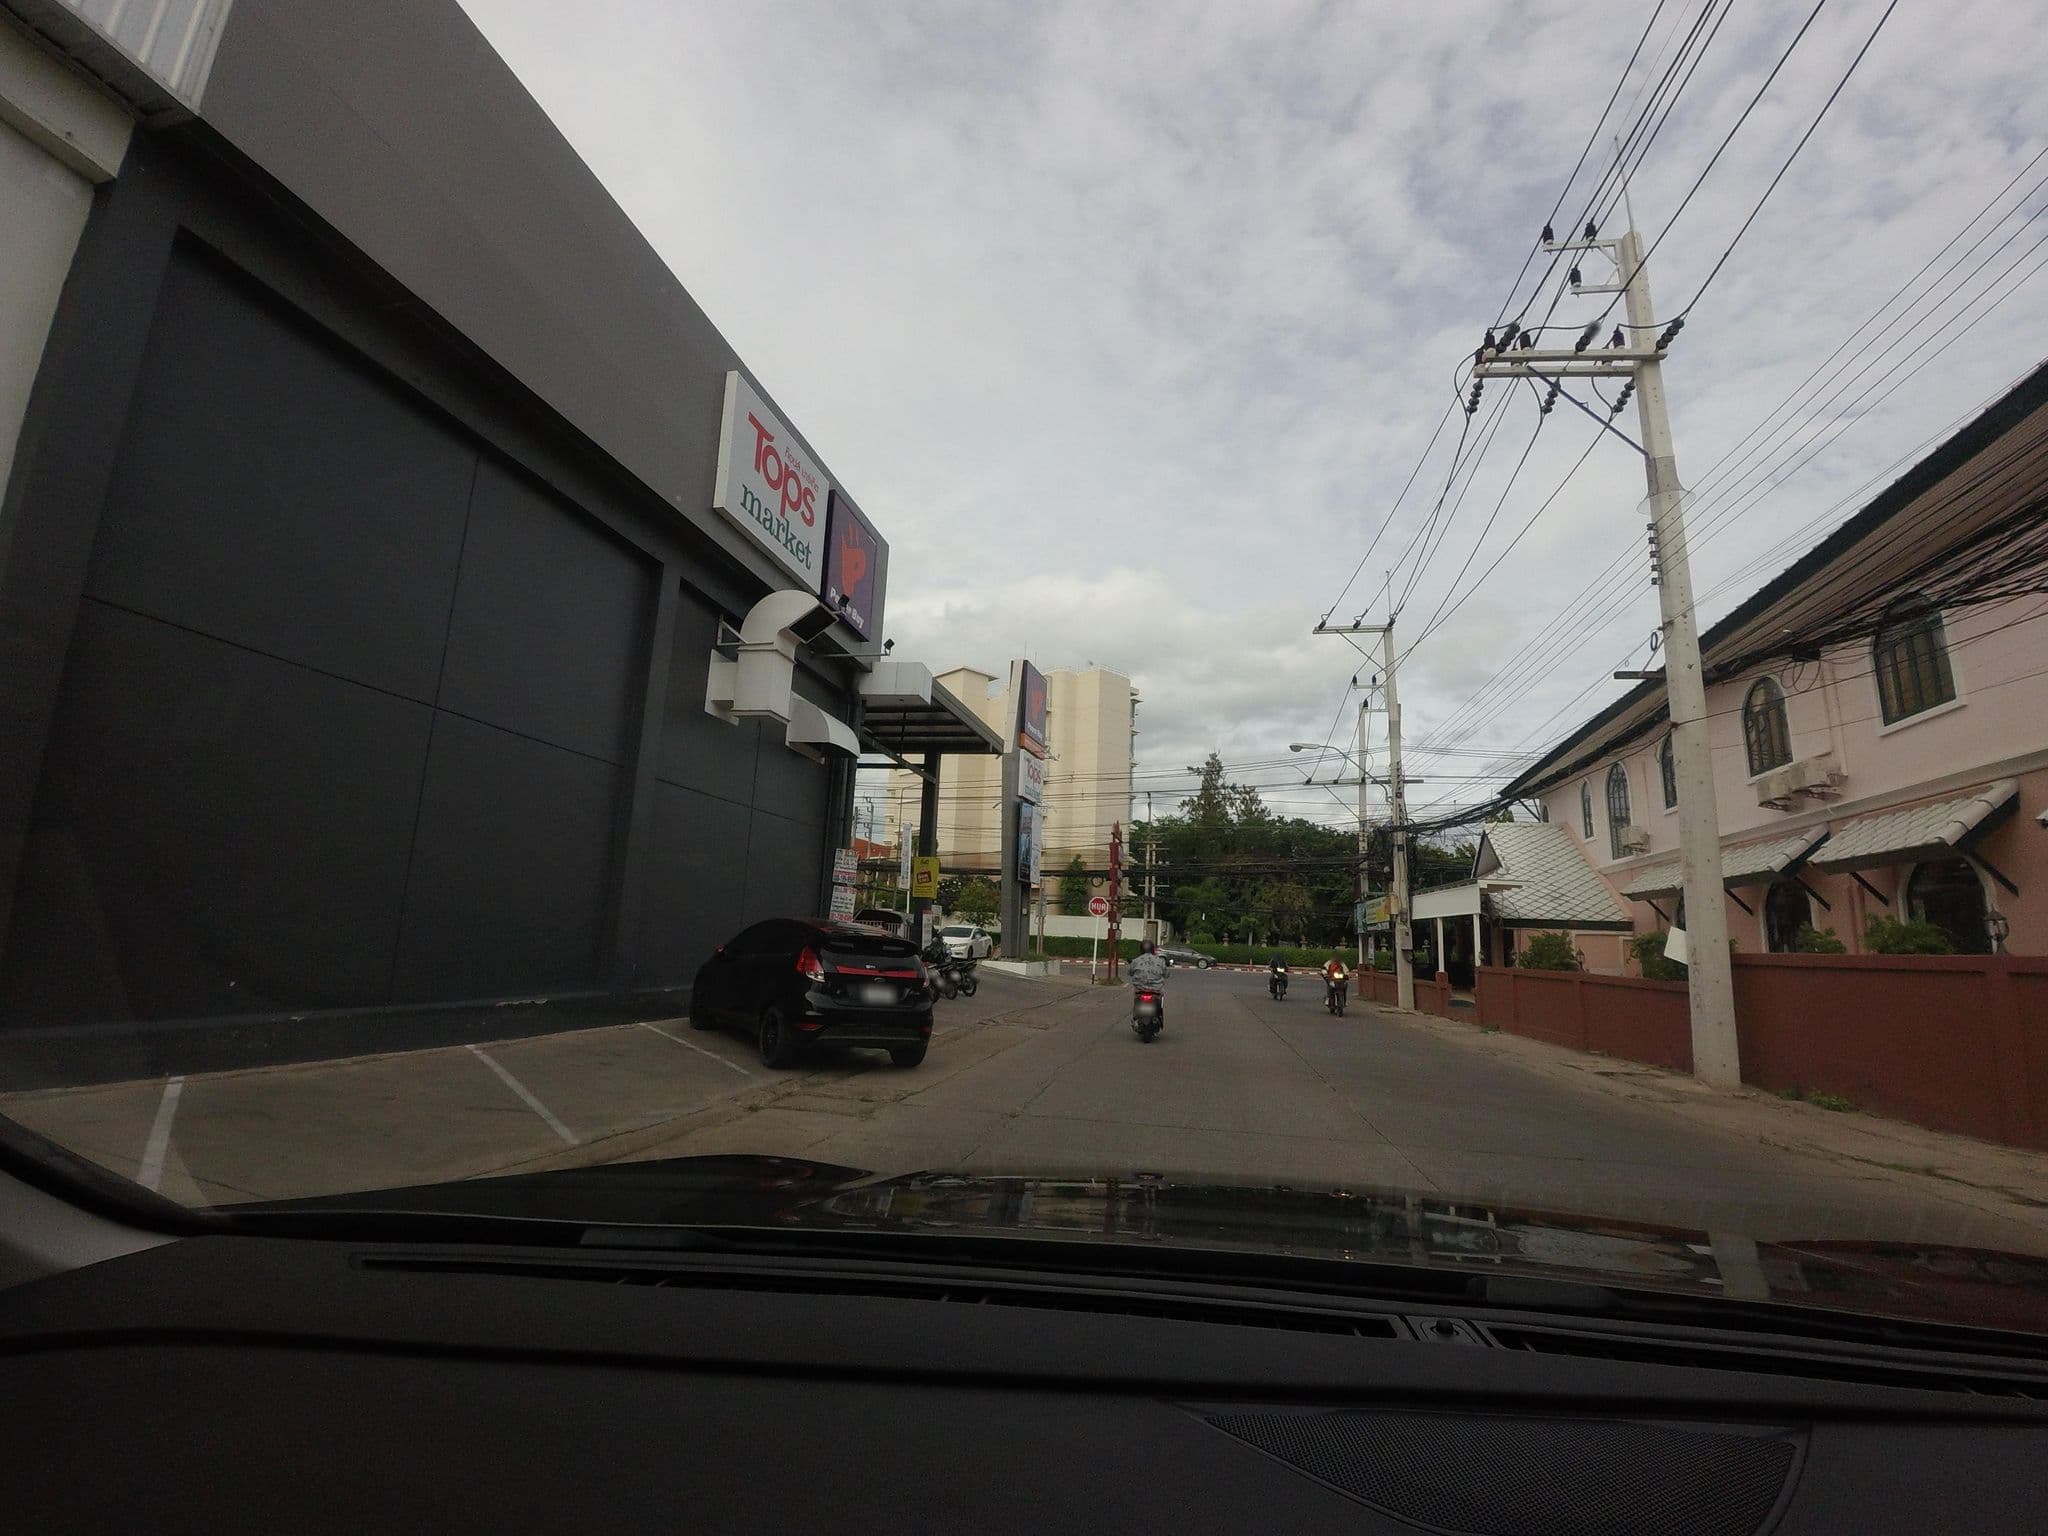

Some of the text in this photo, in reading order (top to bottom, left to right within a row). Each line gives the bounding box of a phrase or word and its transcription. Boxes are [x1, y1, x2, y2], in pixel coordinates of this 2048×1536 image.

[748, 411, 815, 528] Tops
[739, 484, 811, 571] market
[852, 608, 865, 629] Buy
